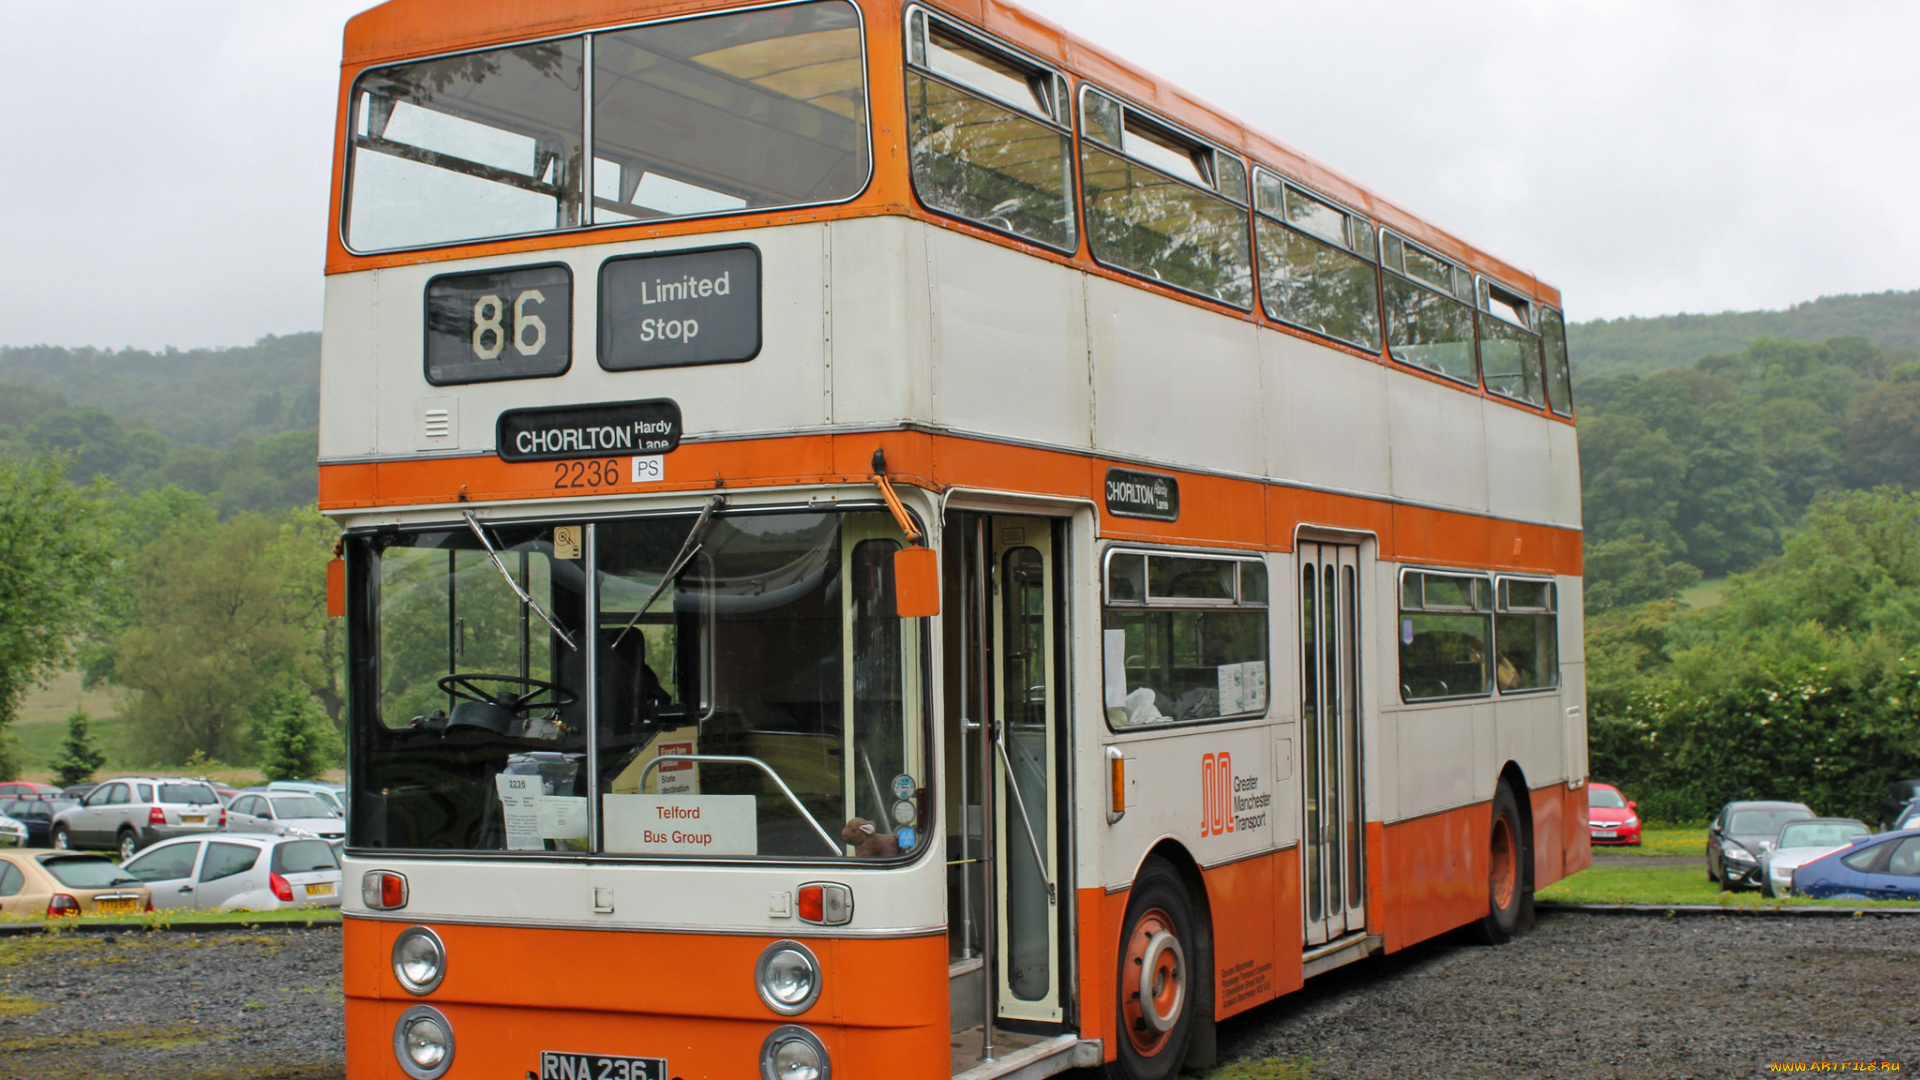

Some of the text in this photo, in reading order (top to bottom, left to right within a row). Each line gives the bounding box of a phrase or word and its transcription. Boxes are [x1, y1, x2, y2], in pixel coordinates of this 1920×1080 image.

[641, 270, 731, 305] Limited
[472, 289, 547, 361] 86
[639, 317, 699, 344] Stop
[634, 419, 672, 435] Hardy
[516, 425, 631, 453] CHORLTON
[637, 437, 670, 450] Lane
[554, 459, 619, 489] 2236
[637, 460, 659, 477] PS
[1106, 481, 1154, 505] CHORLTON
[1155, 498, 1169, 510] Lane
[509, 780, 526, 789] 2236
[661, 775, 676, 784] State
[1233, 775, 1259, 793] Greater
[661, 783, 690, 795] destination
[1233, 792, 1271, 813] Manchester
[656, 806, 701, 819] Telford
[1234, 811, 1266, 833] Transport
[643, 829, 712, 847] Bus Group
[543, 1054, 592, 1080] RNA
